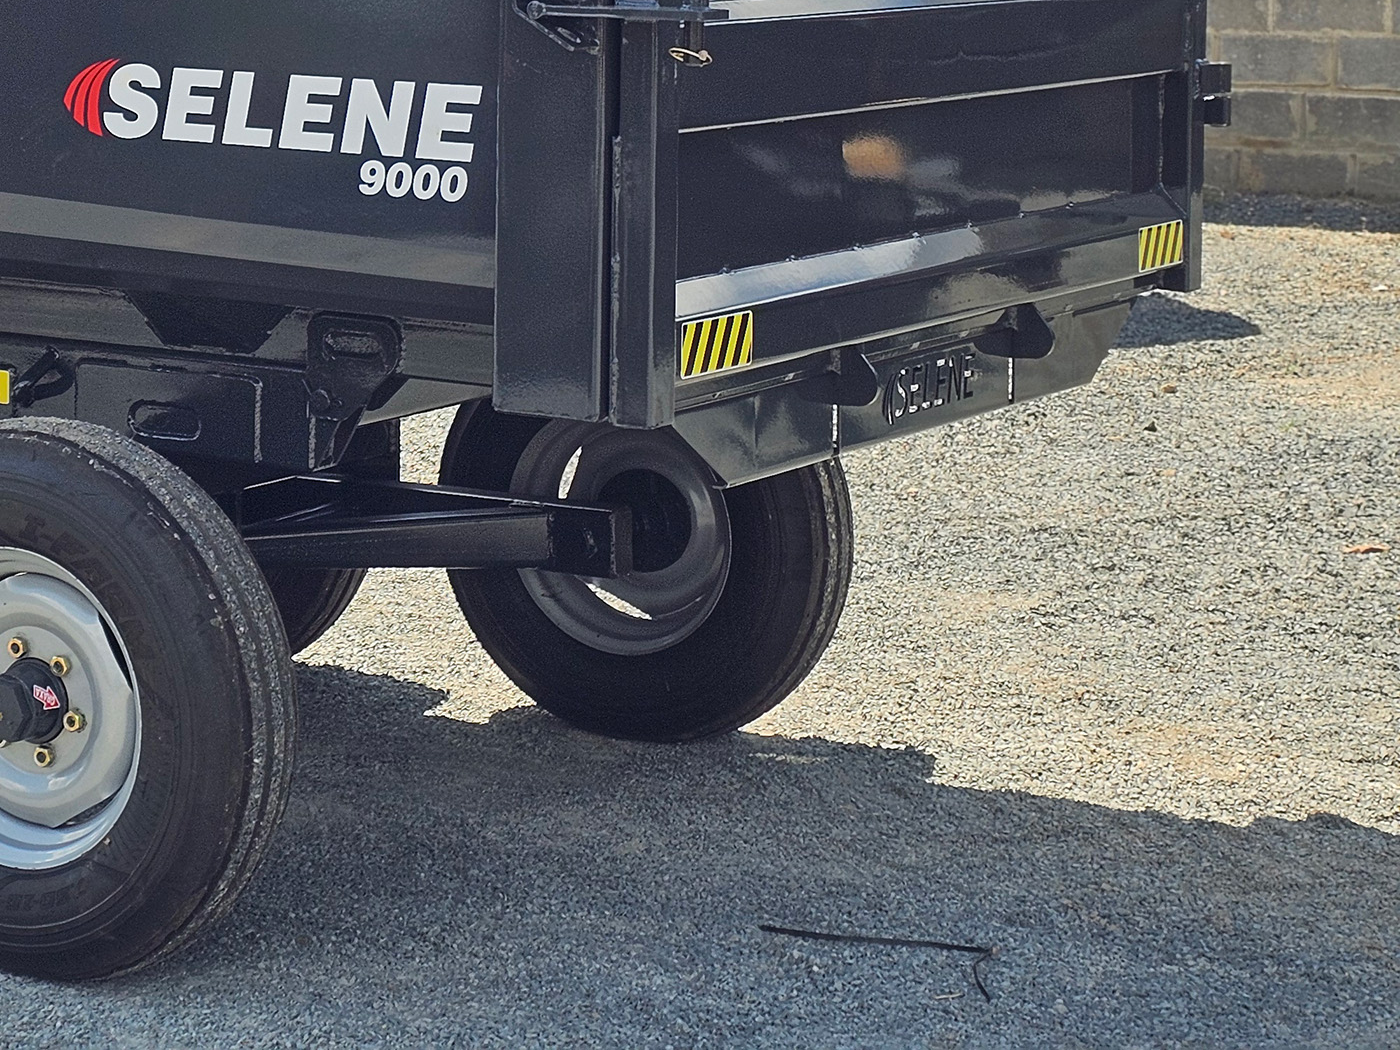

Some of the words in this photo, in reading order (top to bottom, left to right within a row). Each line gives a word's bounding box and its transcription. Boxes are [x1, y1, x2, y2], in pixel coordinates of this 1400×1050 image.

[103, 63, 483, 163] SELENE
[358, 160, 468, 203] 9000
[895, 352, 975, 418] SELENE
